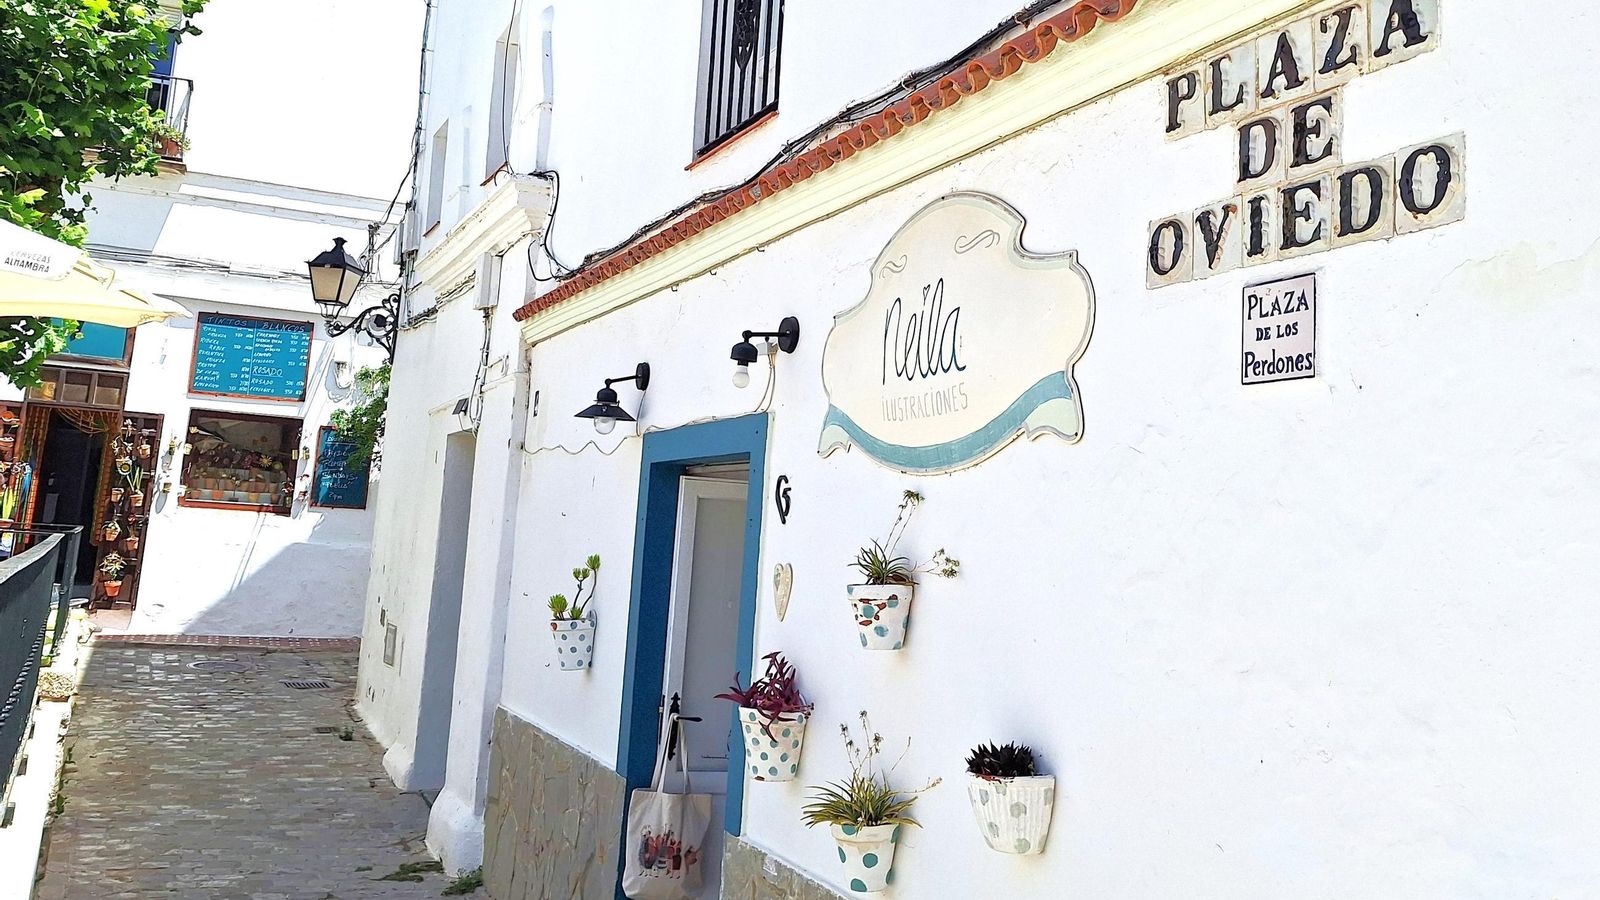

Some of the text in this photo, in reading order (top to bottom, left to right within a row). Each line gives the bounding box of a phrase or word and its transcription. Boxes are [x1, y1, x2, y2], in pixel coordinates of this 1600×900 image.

[1166, 0, 1429, 133] PLAZA
[1237, 96, 1334, 183] DE
[1150, 145, 1451, 275] OVIEDO
[4, 257, 49, 272] ALHAMBRA
[1247, 288, 1309, 320] PLAZA
[207, 316, 248, 327] TINTOS
[262, 321, 306, 333] BLANCOS
[1255, 321, 1299, 341] DE LOS
[251, 365, 283, 377] ROSADO
[1244, 348, 1313, 378] Perdones
[250, 377, 274, 386] ROSADO
